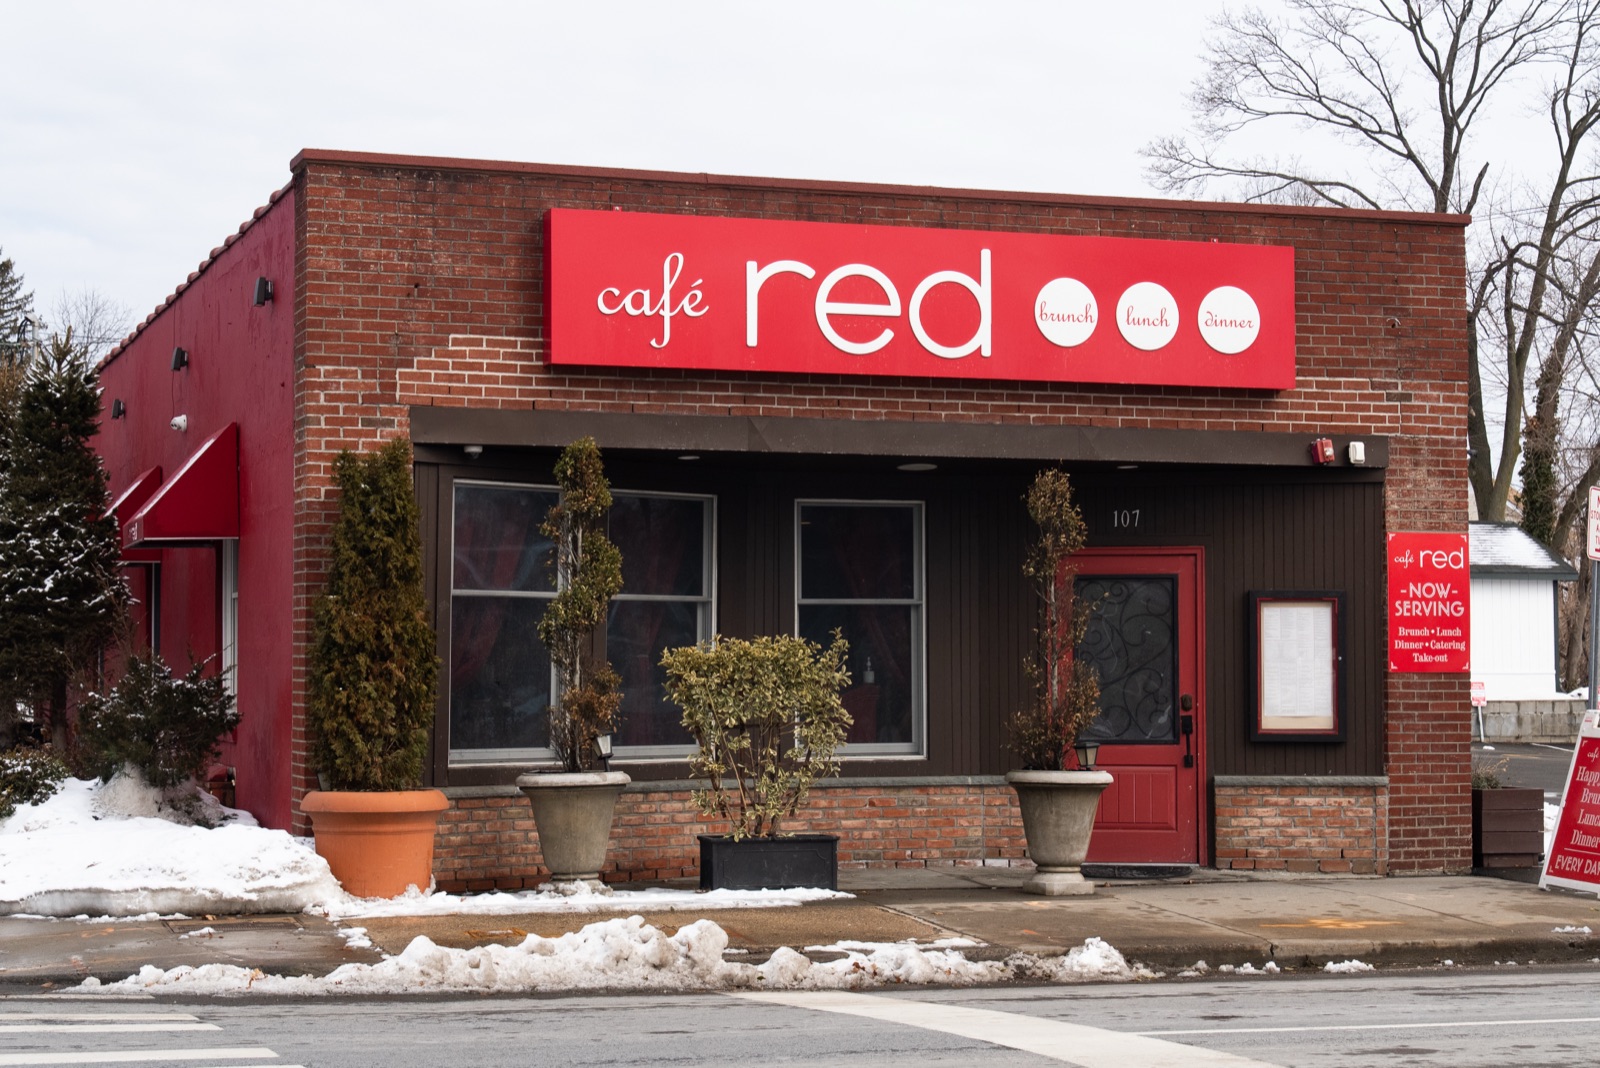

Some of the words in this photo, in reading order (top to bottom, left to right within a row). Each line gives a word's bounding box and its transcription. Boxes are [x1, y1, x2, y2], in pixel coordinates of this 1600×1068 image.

[597, 252, 710, 348] café
[746, 248, 992, 359] red
[1039, 300, 1096, 324] brunch
[1125, 305, 1171, 328] lunch
[1204, 311, 1254, 328] dinner
[1113, 509, 1140, 528] 107
[1394, 549, 1415, 569] café
[1419, 547, 1465, 569] red
[1394, 600, 1465, 617] SERVING
[1398, 627, 1430, 637] Brunch
[1436, 627, 1462, 637] Lunch
[1394, 640, 1424, 650] Dinner
[1430, 640, 1466, 651] Catering
[1413, 653, 1449, 663] Take-out
[1576, 765, 1600, 786] Happ
[1577, 808, 1600, 827] Lunc
[1570, 829, 1600, 848] Dinner
[1555, 854, 1584, 873] EVERY
